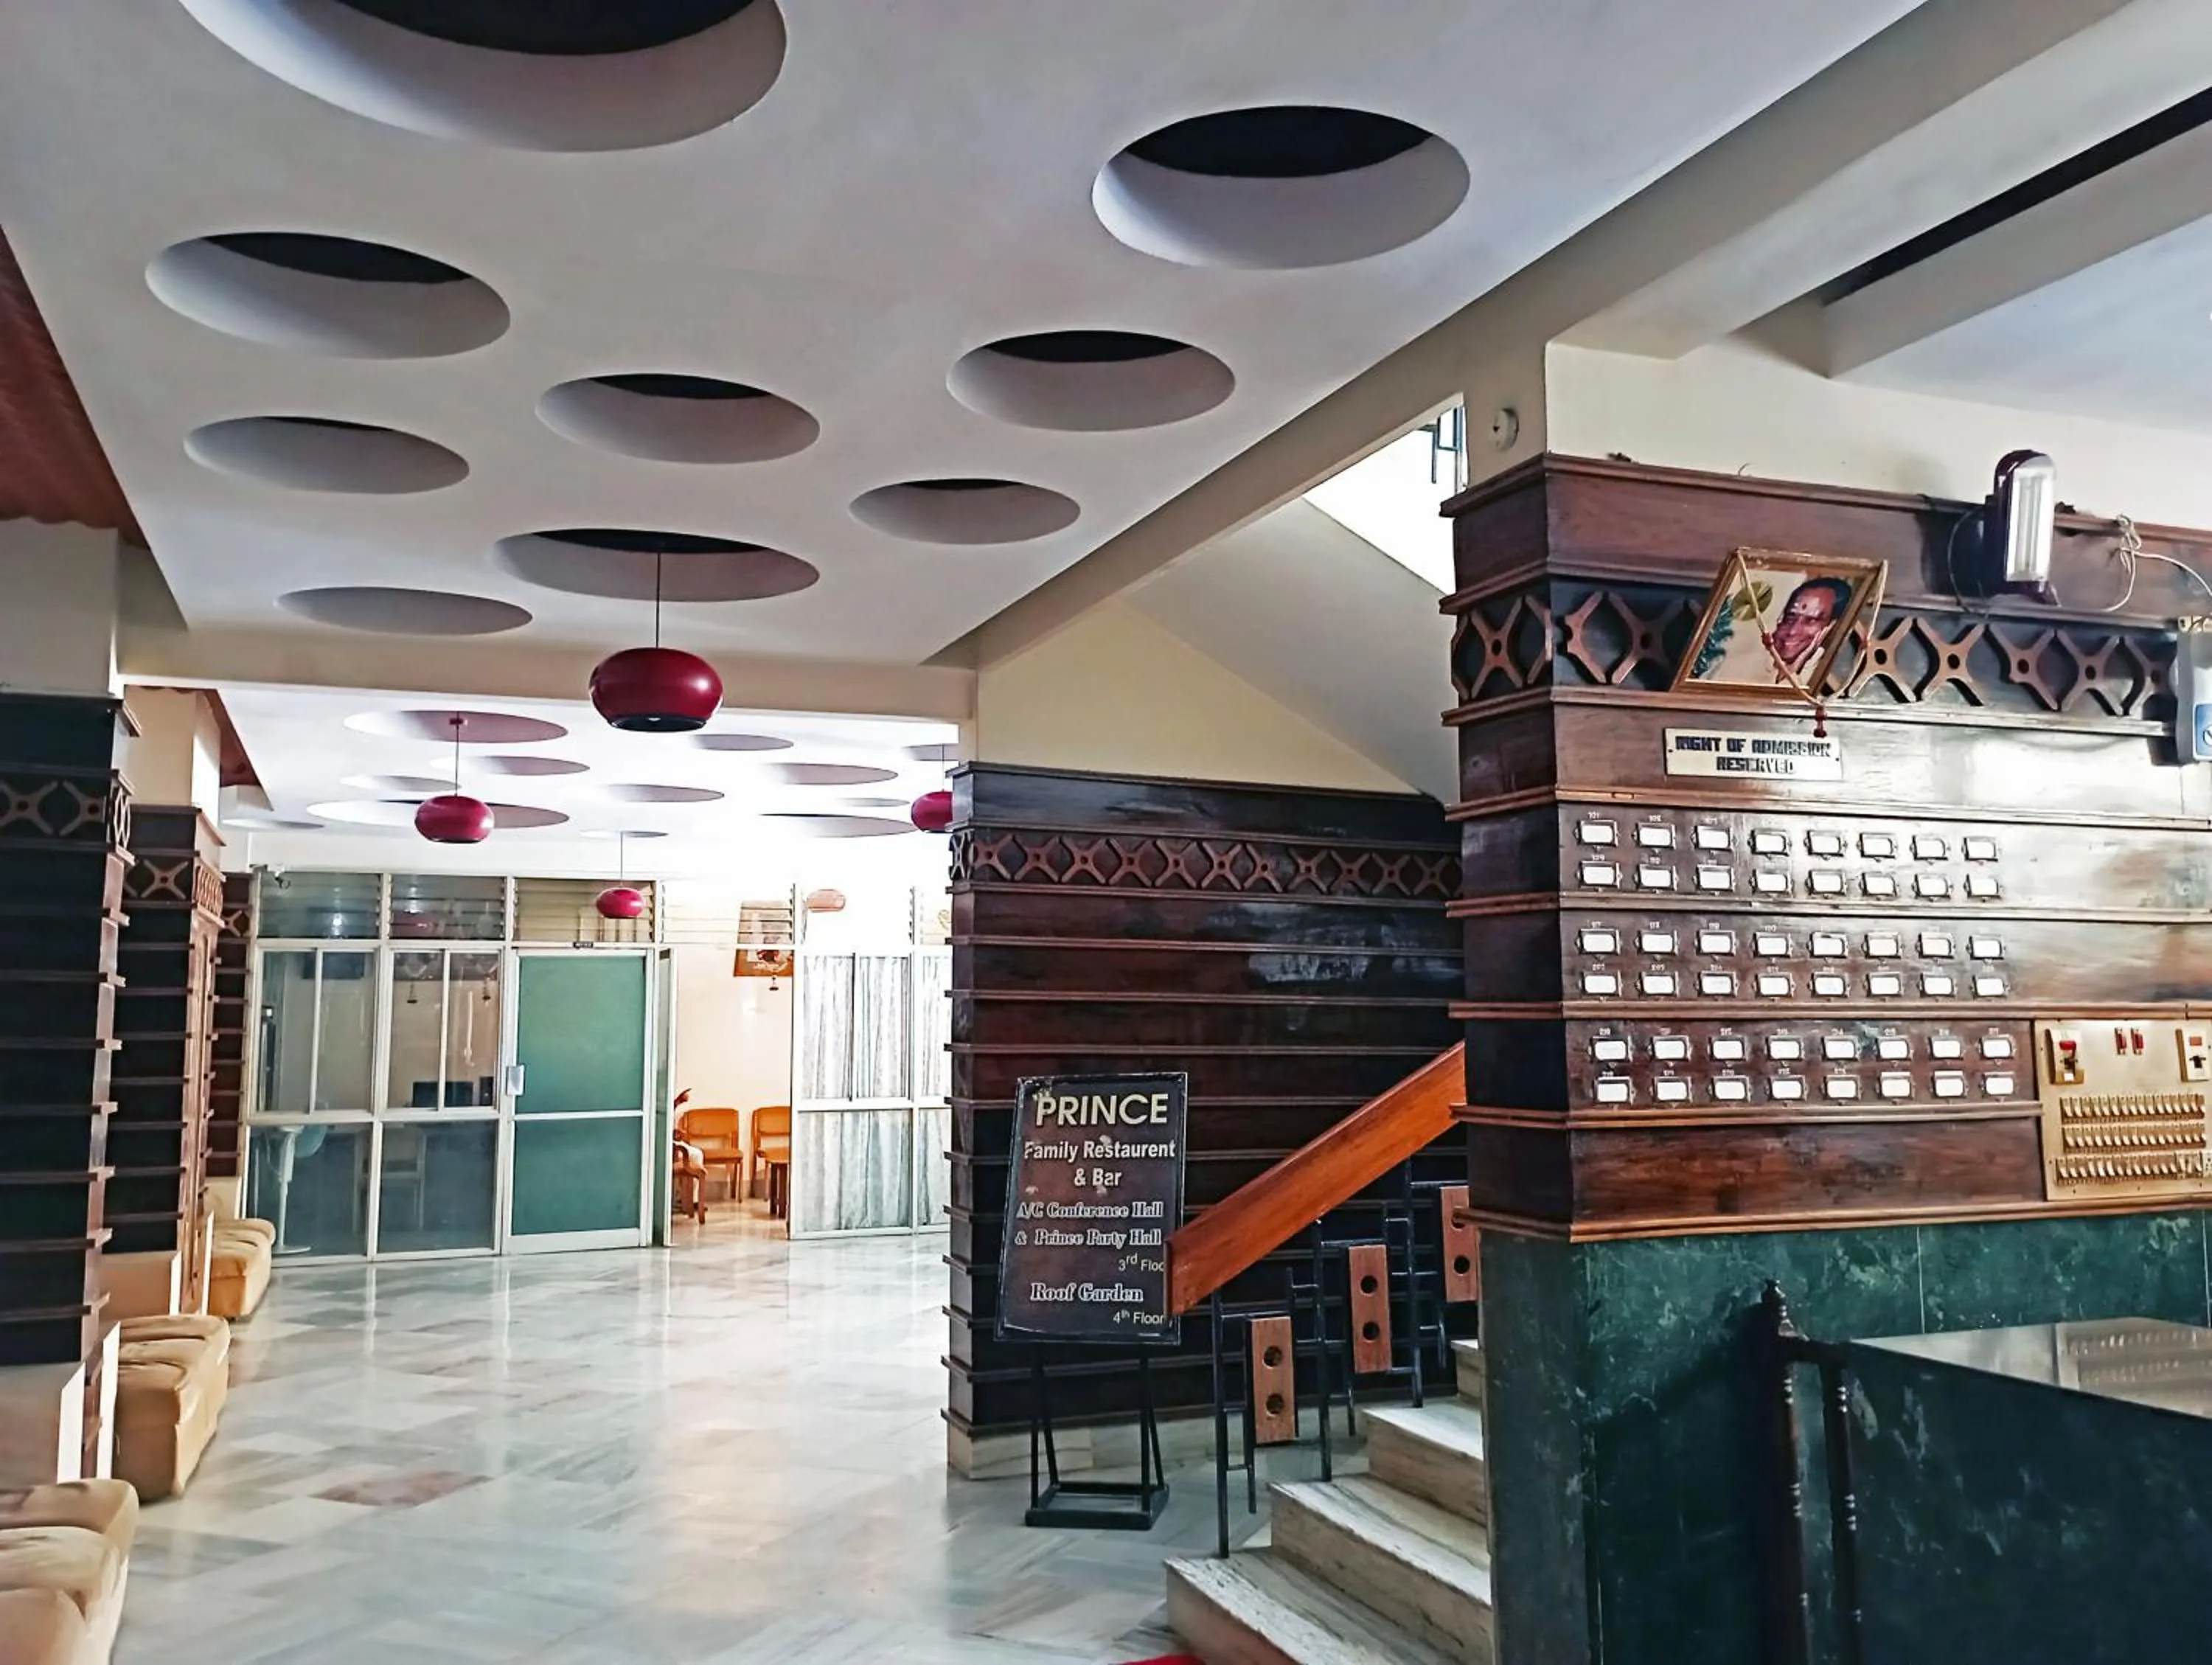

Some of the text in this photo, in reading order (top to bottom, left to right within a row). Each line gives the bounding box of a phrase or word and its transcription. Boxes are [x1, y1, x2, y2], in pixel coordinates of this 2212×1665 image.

[1675, 736, 1831, 757] RIGHT OF ADMISSION
[1717, 757, 1794, 774] RESERVED
[1036, 1094, 1169, 1126] PRINCE
[1024, 1139, 1176, 1163] Family Restaurent
[1074, 1167, 1121, 1186] & Bar
[1016, 1201, 1164, 1219] A/C Conference Hall
[1015, 1228, 1161, 1249] & Prince Party Hall
[1030, 1282, 1144, 1301] Roof Garden
[1133, 1312, 1165, 1324] Floor
